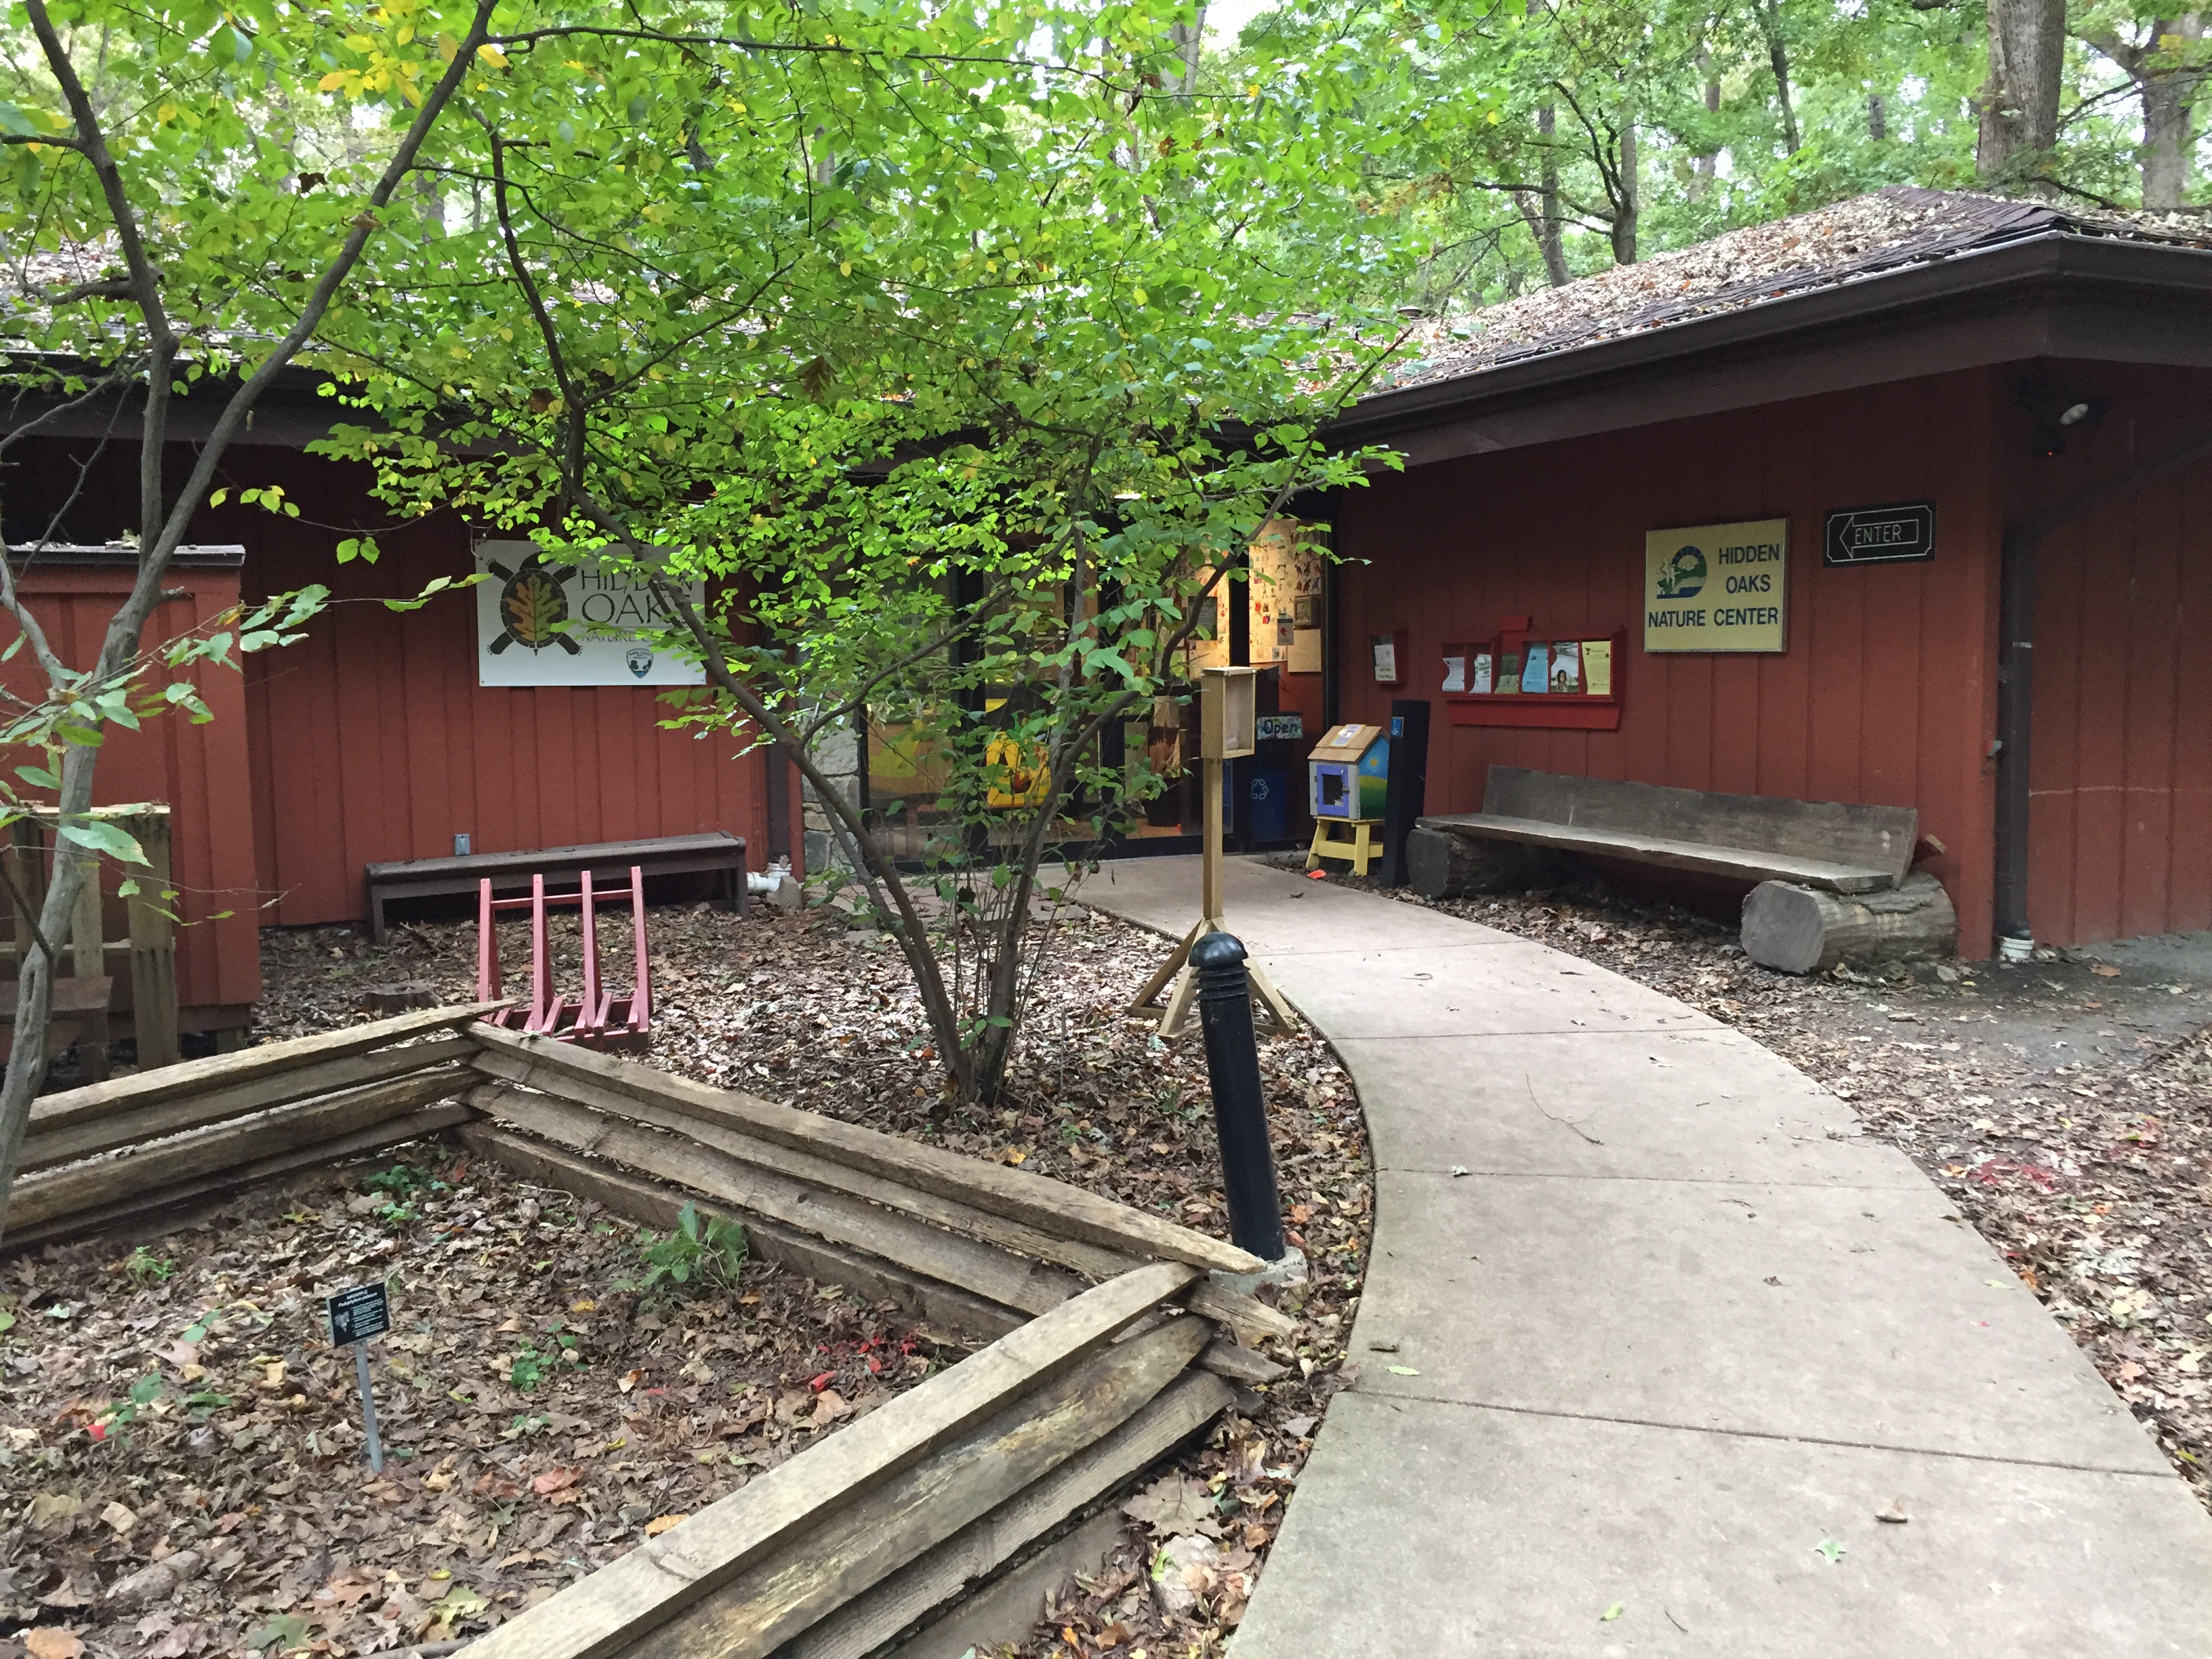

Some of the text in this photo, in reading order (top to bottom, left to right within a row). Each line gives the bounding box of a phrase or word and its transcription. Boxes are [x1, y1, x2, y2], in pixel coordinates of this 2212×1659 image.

[1855, 524, 1902, 545] ENTER
[1718, 544, 1780, 565] HIDDEN
[1725, 574, 1771, 594] OAKS
[581, 593, 691, 624] OAK
[1647, 607, 1779, 628] NATURE CENTER
[1263, 719, 1298, 738] Open
